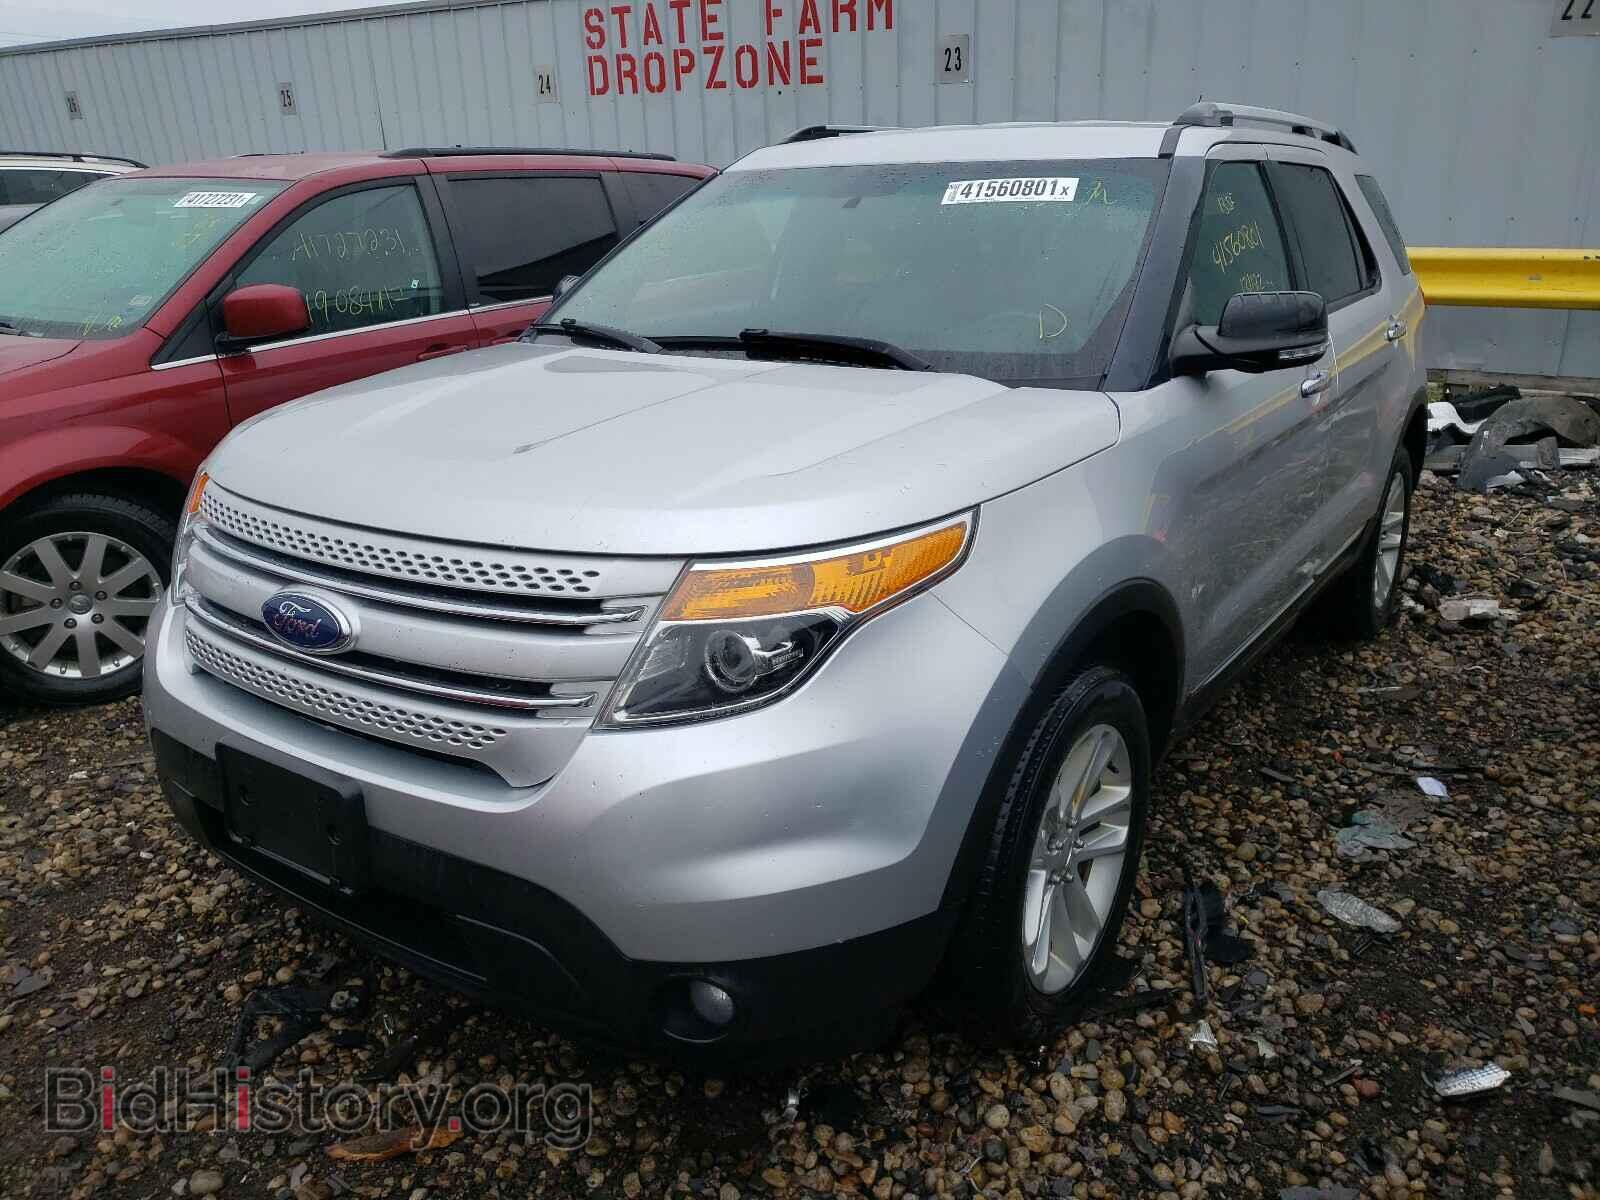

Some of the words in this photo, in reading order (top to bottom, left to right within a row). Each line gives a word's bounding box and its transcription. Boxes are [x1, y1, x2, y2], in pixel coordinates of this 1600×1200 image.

[584, 0, 724, 49] STATE
[766, 0, 893, 35] FARM
[587, 38, 824, 96] DROPZONE
[944, 46, 962, 72] 23
[538, 74, 551, 94] 24
[1039, 303, 1068, 340] D
[273, 601, 323, 638] Ford
